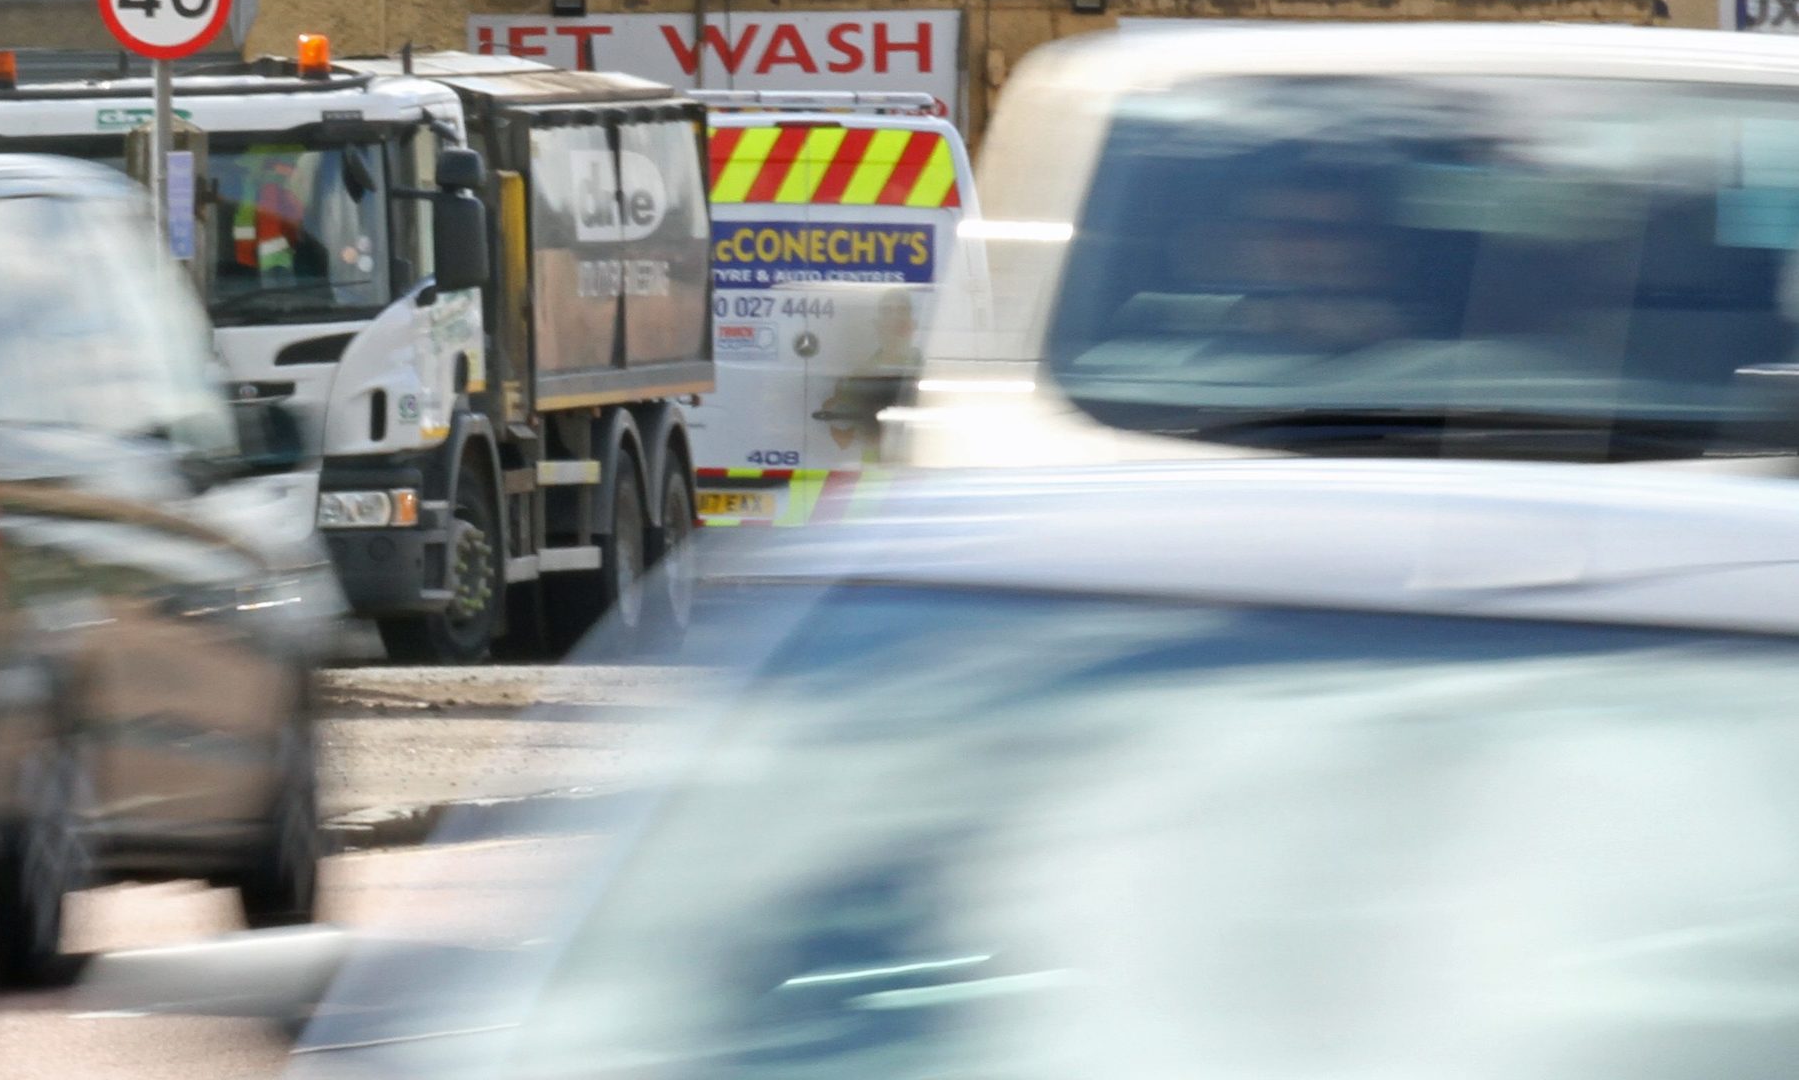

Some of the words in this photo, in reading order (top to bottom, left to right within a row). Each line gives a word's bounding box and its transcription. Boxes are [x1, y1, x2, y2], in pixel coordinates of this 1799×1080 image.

[659, 22, 933, 75] WASH
[754, 269, 770, 282] &
[734, 296, 776, 318] 027
